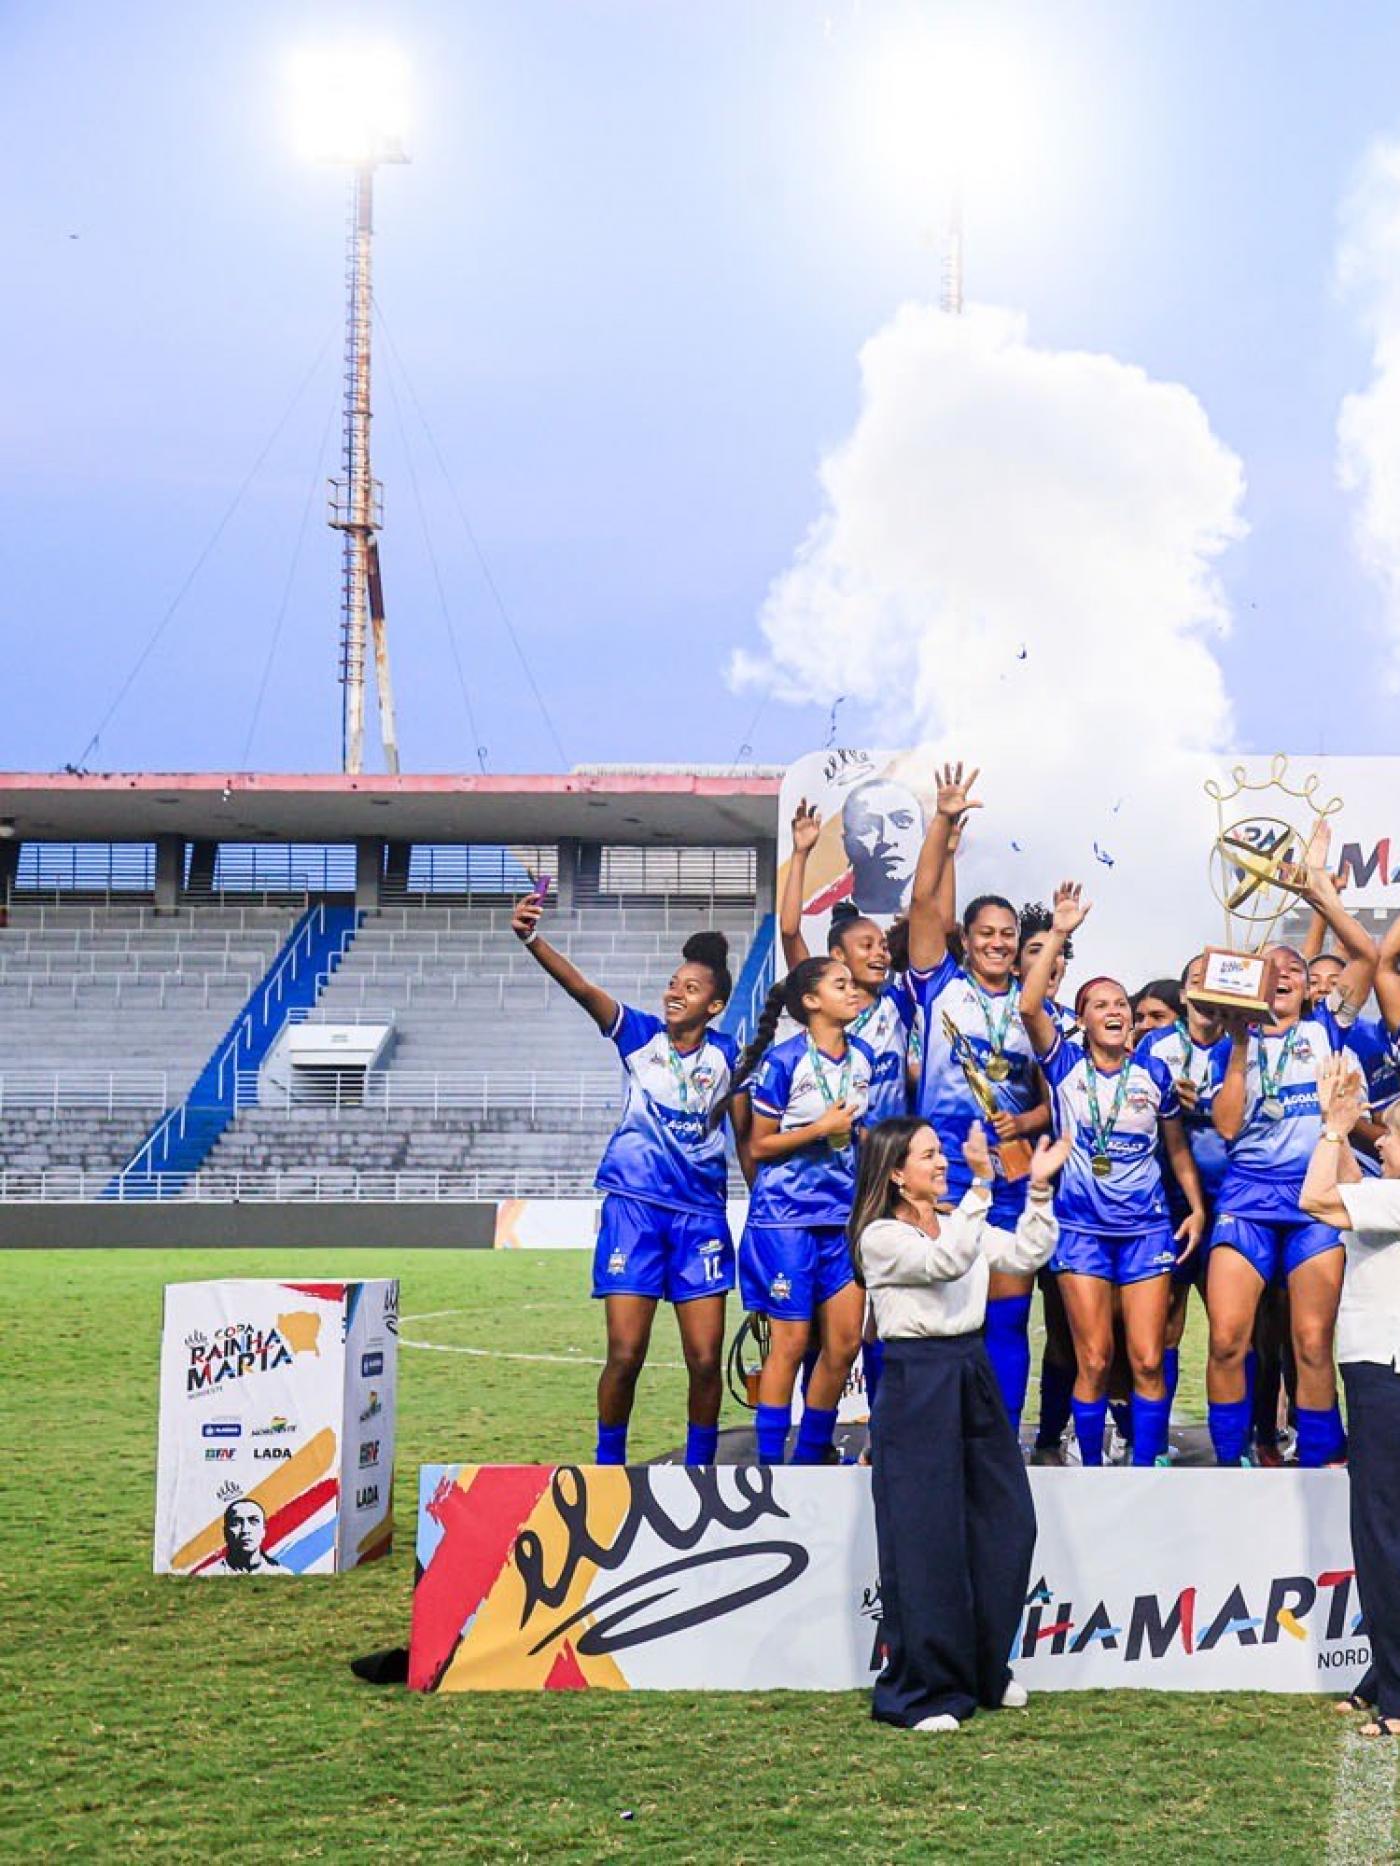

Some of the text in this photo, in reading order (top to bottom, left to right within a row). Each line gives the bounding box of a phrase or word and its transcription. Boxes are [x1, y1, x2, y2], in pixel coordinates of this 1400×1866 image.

[214, 1322, 255, 1339] COPA
[190, 1327, 284, 1366] RAINHA
[186, 1344, 295, 1392] MARTA
[253, 1447, 292, 1460] LADA
[1317, 1647, 1371, 1669] NORD
